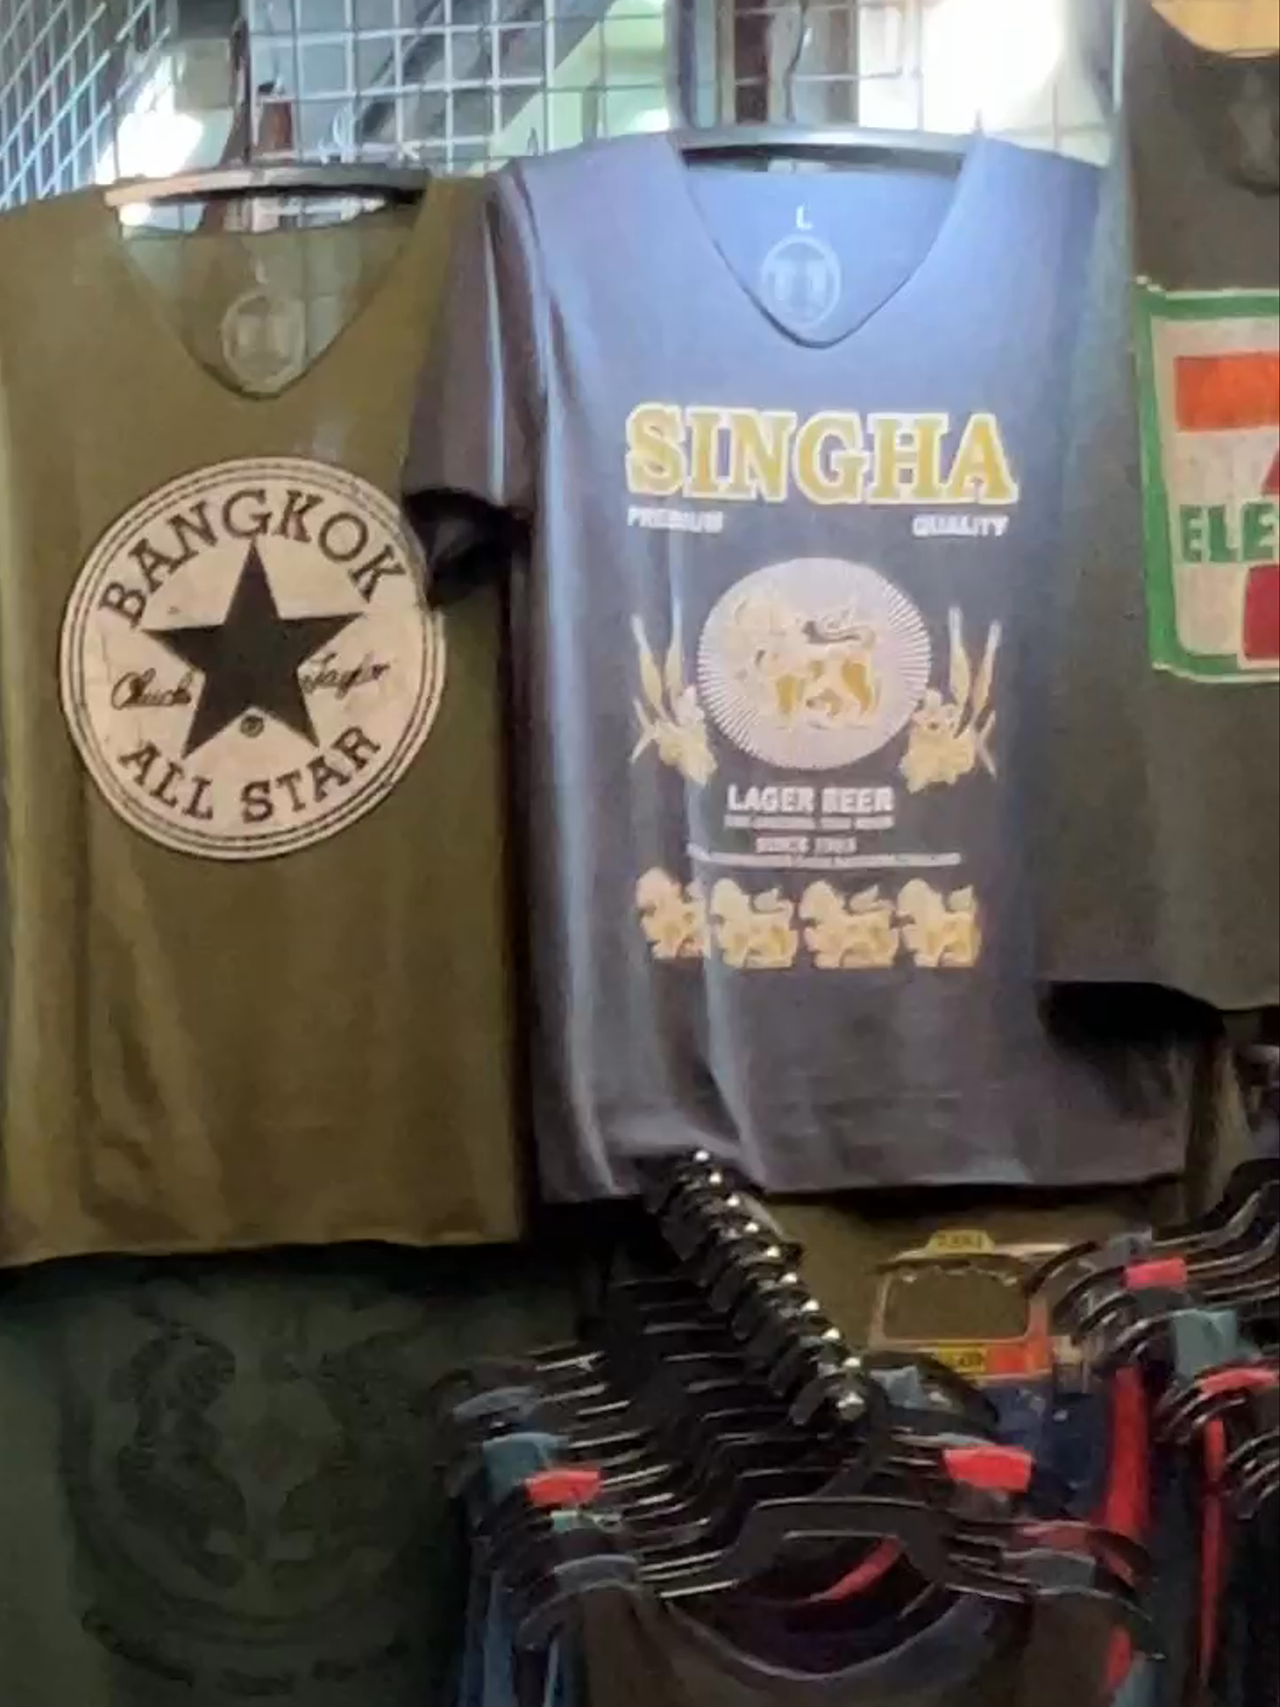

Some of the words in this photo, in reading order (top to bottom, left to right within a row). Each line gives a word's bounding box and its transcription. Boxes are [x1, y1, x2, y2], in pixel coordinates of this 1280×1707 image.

[625, 403, 1019, 505] SINGHA
[97, 489, 407, 628] BANGKOK
[912, 514, 1009, 537] QUALITY
[120, 740, 214, 820] ALL
[242, 726, 382, 823] STAR
[727, 784, 815, 812] LAGER
[821, 786, 895, 813] BEER
